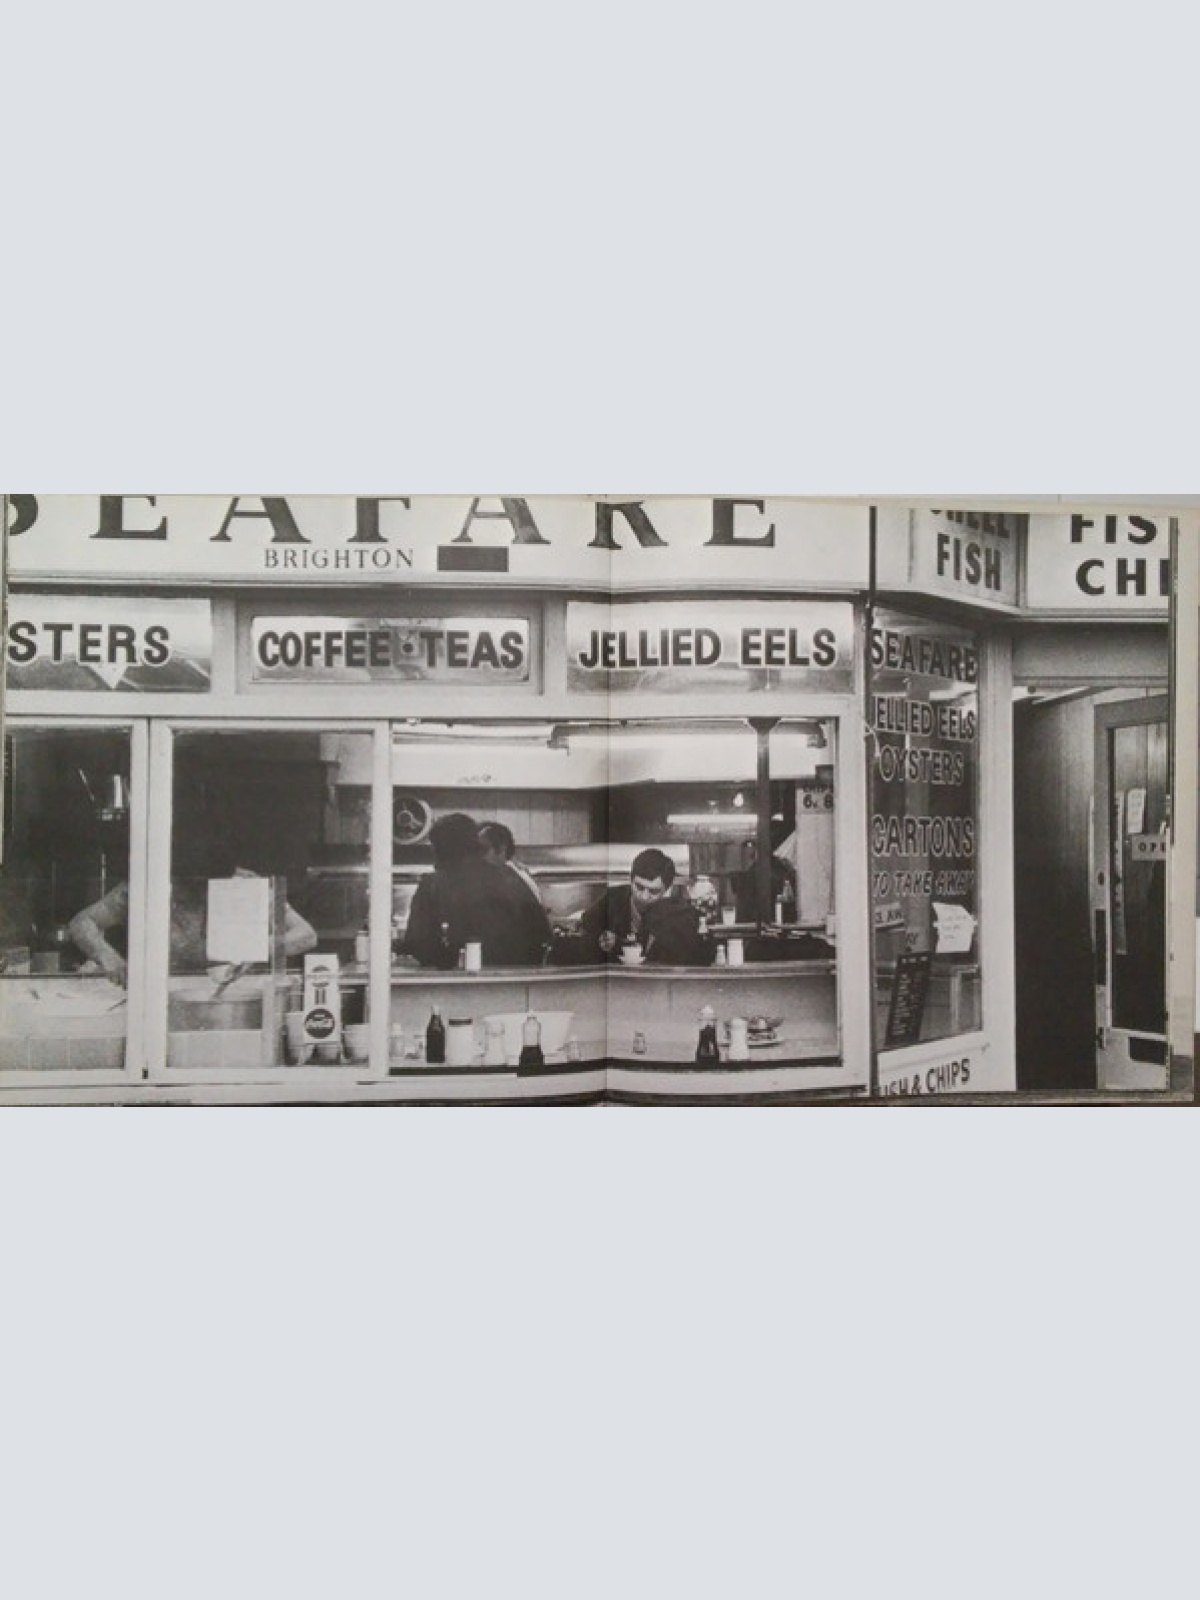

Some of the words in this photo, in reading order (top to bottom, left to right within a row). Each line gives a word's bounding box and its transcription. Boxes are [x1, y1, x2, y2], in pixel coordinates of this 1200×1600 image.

[264, 548, 414, 569] BRIGHTON
[937, 532, 1001, 590] FISH
[8, 621, 171, 664] STERS
[258, 630, 392, 668] COFFEE
[419, 631, 524, 669] TEAS
[578, 629, 722, 669] JELLIED
[741, 628, 838, 668] EELS
[871, 628, 978, 684] SEAFARE
[875, 696, 933, 736] ELLIED
[937, 705, 977, 741] EELS
[879, 744, 965, 785] OYSTERS
[872, 813, 976, 858] CARTONS
[894, 870, 933, 897] TAKE
[925, 1057, 970, 1094] CHIPS
